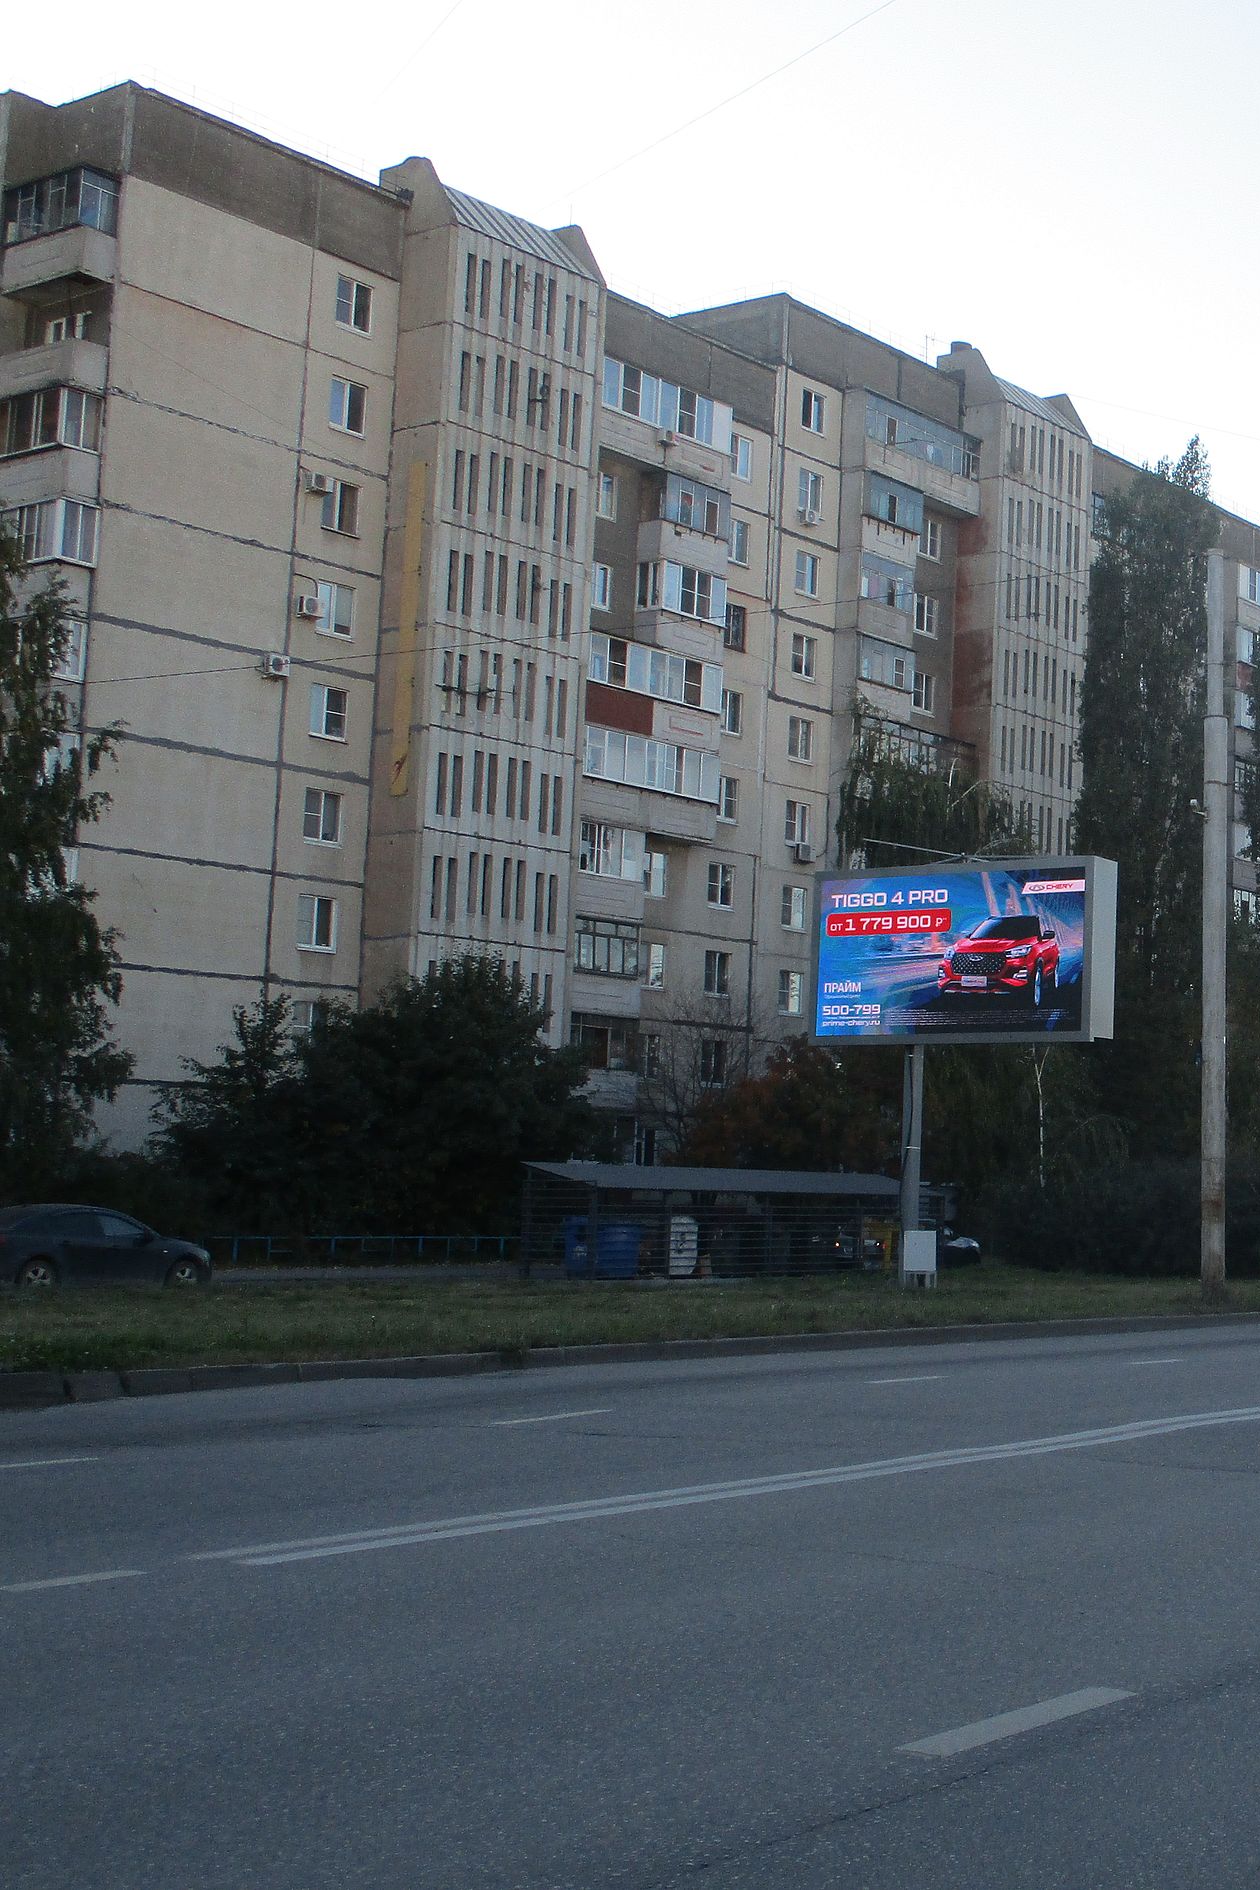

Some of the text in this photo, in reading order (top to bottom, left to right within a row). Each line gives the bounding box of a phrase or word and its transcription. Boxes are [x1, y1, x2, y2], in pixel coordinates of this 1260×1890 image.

[831, 889, 949, 908] TIGGO 4 PRO
[845, 919, 856, 931] 1
[860, 917, 893, 930] 779
[896, 915, 931, 929] 900
[824, 980, 862, 993] ПРАЙМ
[822, 1004, 881, 1016] 500-799
